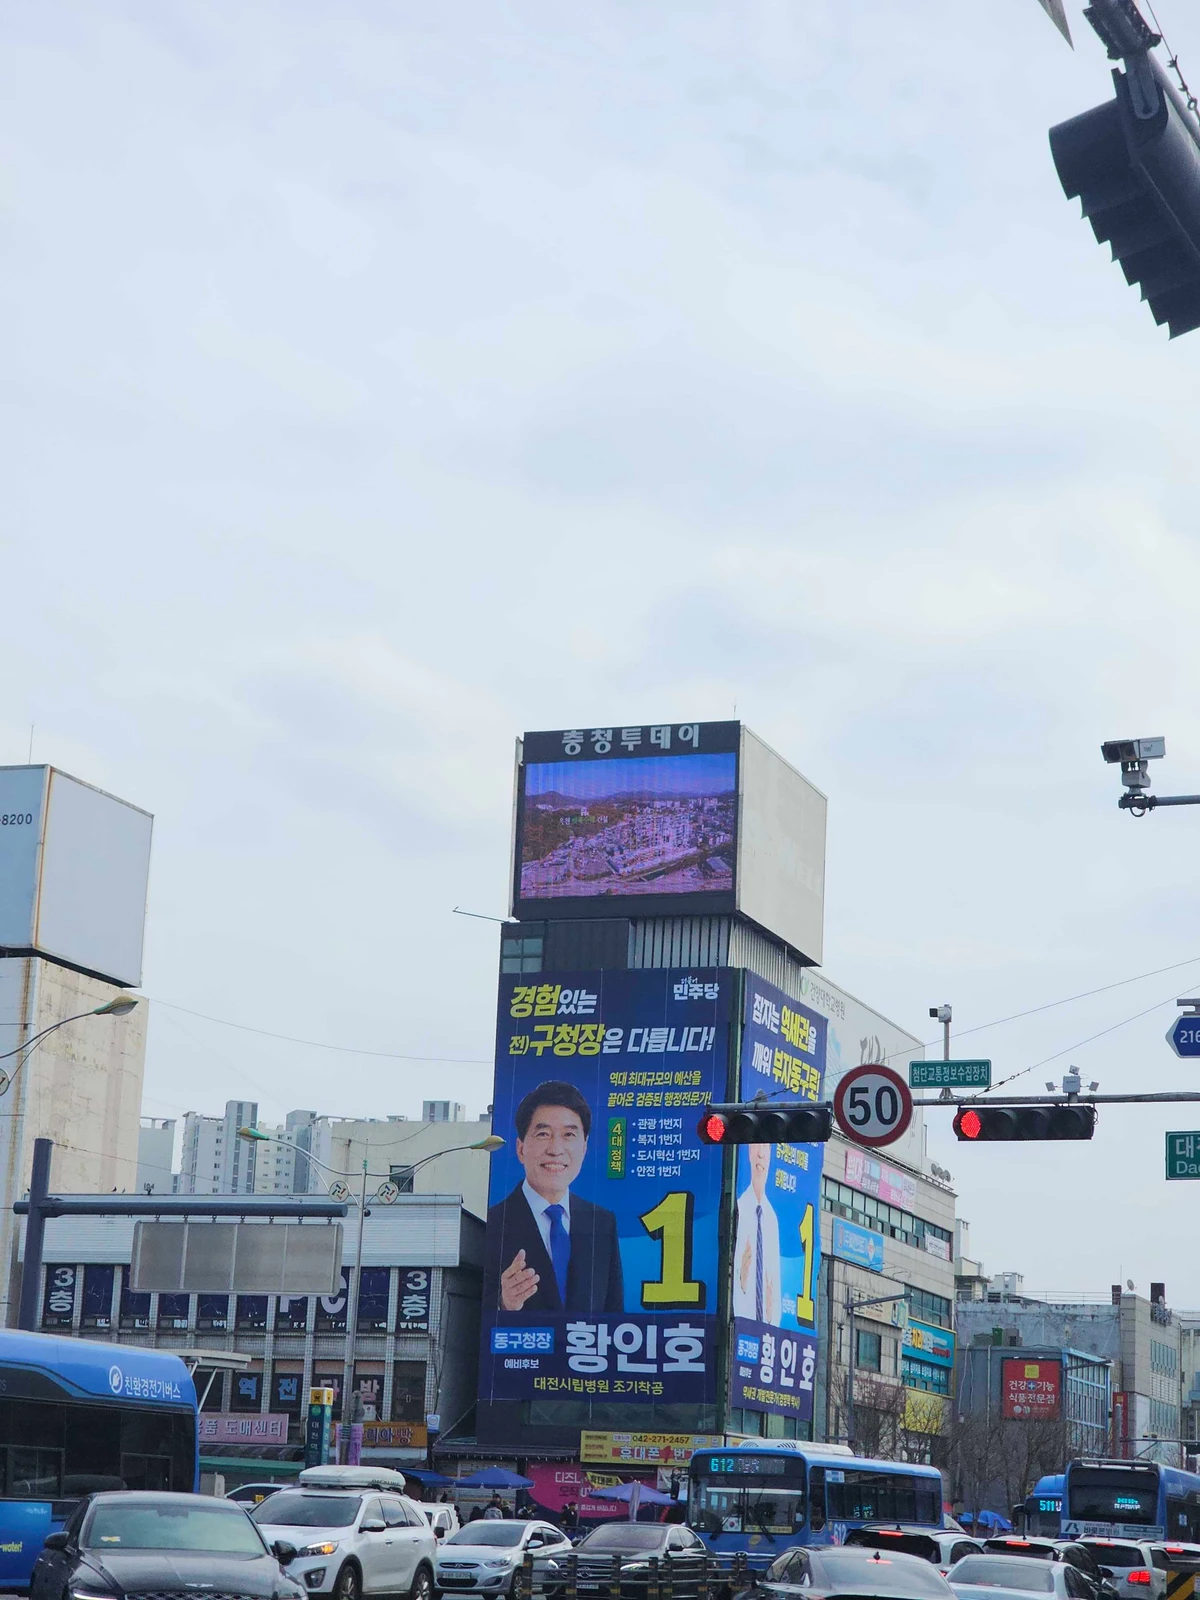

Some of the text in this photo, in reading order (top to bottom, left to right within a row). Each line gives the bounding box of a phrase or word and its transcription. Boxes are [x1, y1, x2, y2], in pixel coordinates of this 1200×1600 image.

[561, 724, 700, 755] 충청투데이
[673, 983, 720, 1000] 민주당
[510, 984, 598, 1018] 경험있는
[810, 982, 846, 1020] 건양대학교병원
[752, 993, 780, 1034] 잠자는
[780, 1005, 817, 1056] 역세권을
[627, 1026, 716, 1054] 다릅니다!
[609, 1070, 702, 1086] 역대 최대규모의 예산을
[913, 1065, 988, 1083] 첨단교통정보수집장치
[607, 1091, 712, 1107] 끌어온 검증된 행정전문가!
[849, 1085, 899, 1126] 50
[637, 1118, 683, 1130] 관광 1번지
[637, 1133, 682, 1146] 복지 1번지
[636, 1149, 700, 1161] 도시혁신 1번지
[636, 1165, 681, 1177] 안전 1번지
[640, 1193, 700, 1302] 1
[797, 1203, 815, 1322] 1
[49, 1267, 75, 1312] 3층
[401, 1270, 428, 1317] 3층
[493, 1332, 552, 1350] 동구청장
[565, 1321, 706, 1373] 황인호
[738, 1339, 759, 1359] 동구청장
[504, 1358, 540, 1370] 예비후보
[760, 1332, 815, 1391] 황인호
[124, 1376, 182, 1399] 친환경전기버스
[533, 1376, 664, 1396] 대전시립병원 조기착공
[1009, 1393, 1055, 1404] 식품전문점
[225, 1419, 283, 1437] 도매센터
[363, 1427, 414, 1445] 리아빵
[632, 1432, 690, 1445] 042-271-2457
[711, 1458, 734, 1472] 612
[1039, 1500, 1055, 1512] 511
